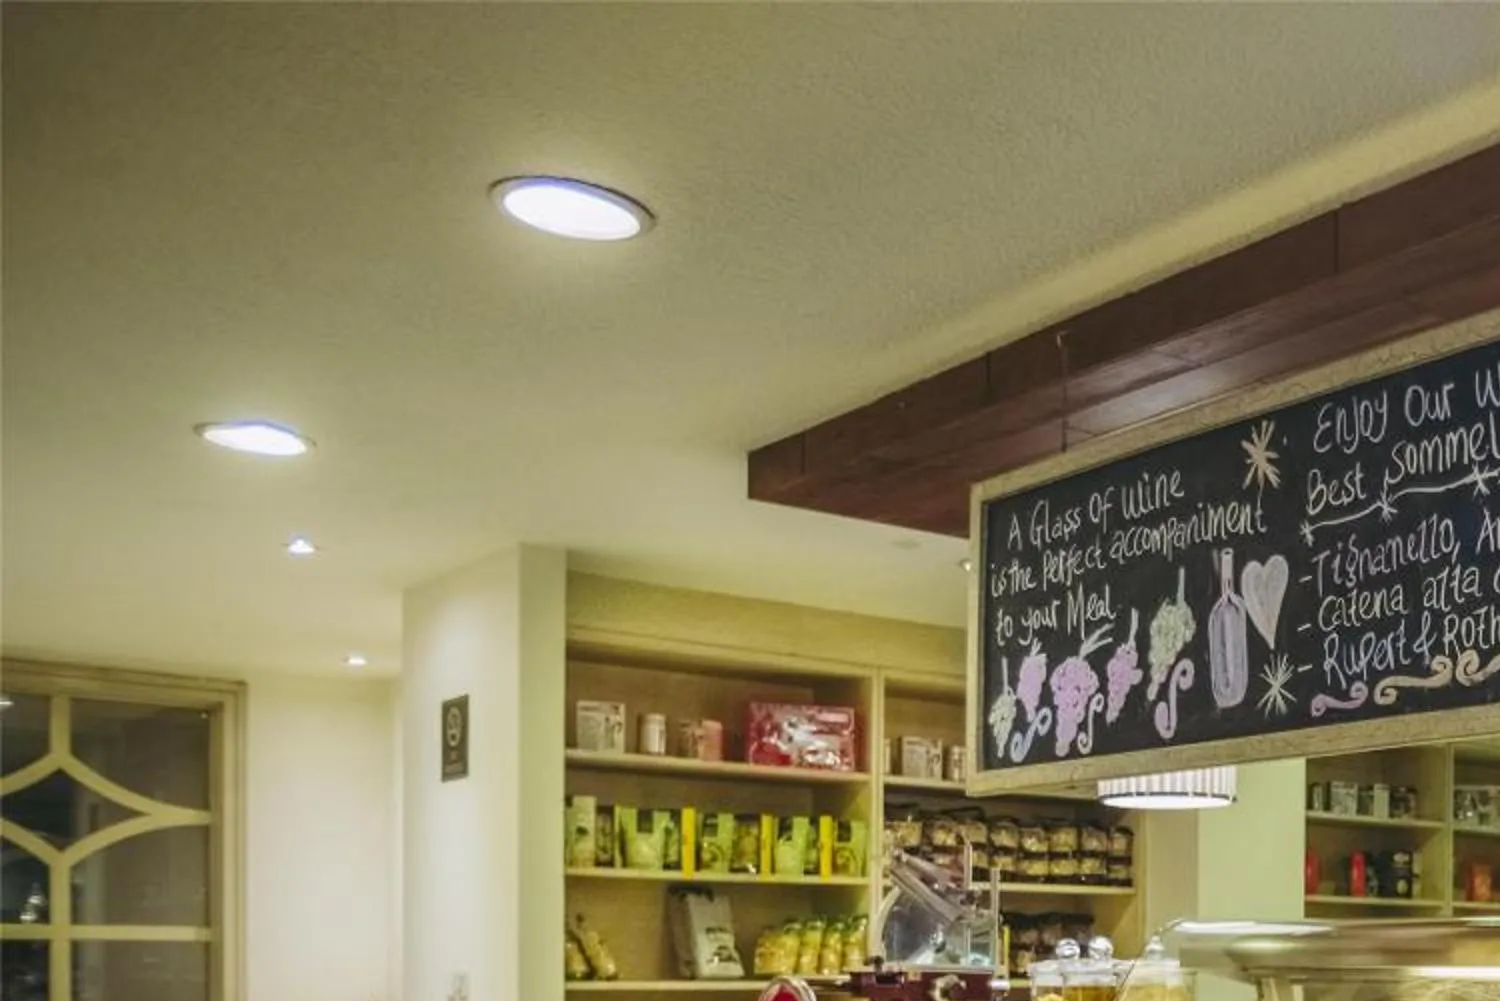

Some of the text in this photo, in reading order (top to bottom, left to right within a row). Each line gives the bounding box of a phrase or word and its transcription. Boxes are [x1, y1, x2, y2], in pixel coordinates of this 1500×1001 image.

[1313, 390, 1387, 454] Enjoy
[1404, 383, 1455, 427] Our
[1306, 461, 1367, 516] Best
[1007, 511, 1022, 550] A
[1029, 500, 1082, 547] Glass
[991, 563, 1007, 598] is
[1007, 558, 1036, 594] the
[995, 608, 1013, 646] to
[1018, 599, 1061, 646] your
[1323, 618, 1411, 690] Rupert
[1413, 610, 1437, 666] &
